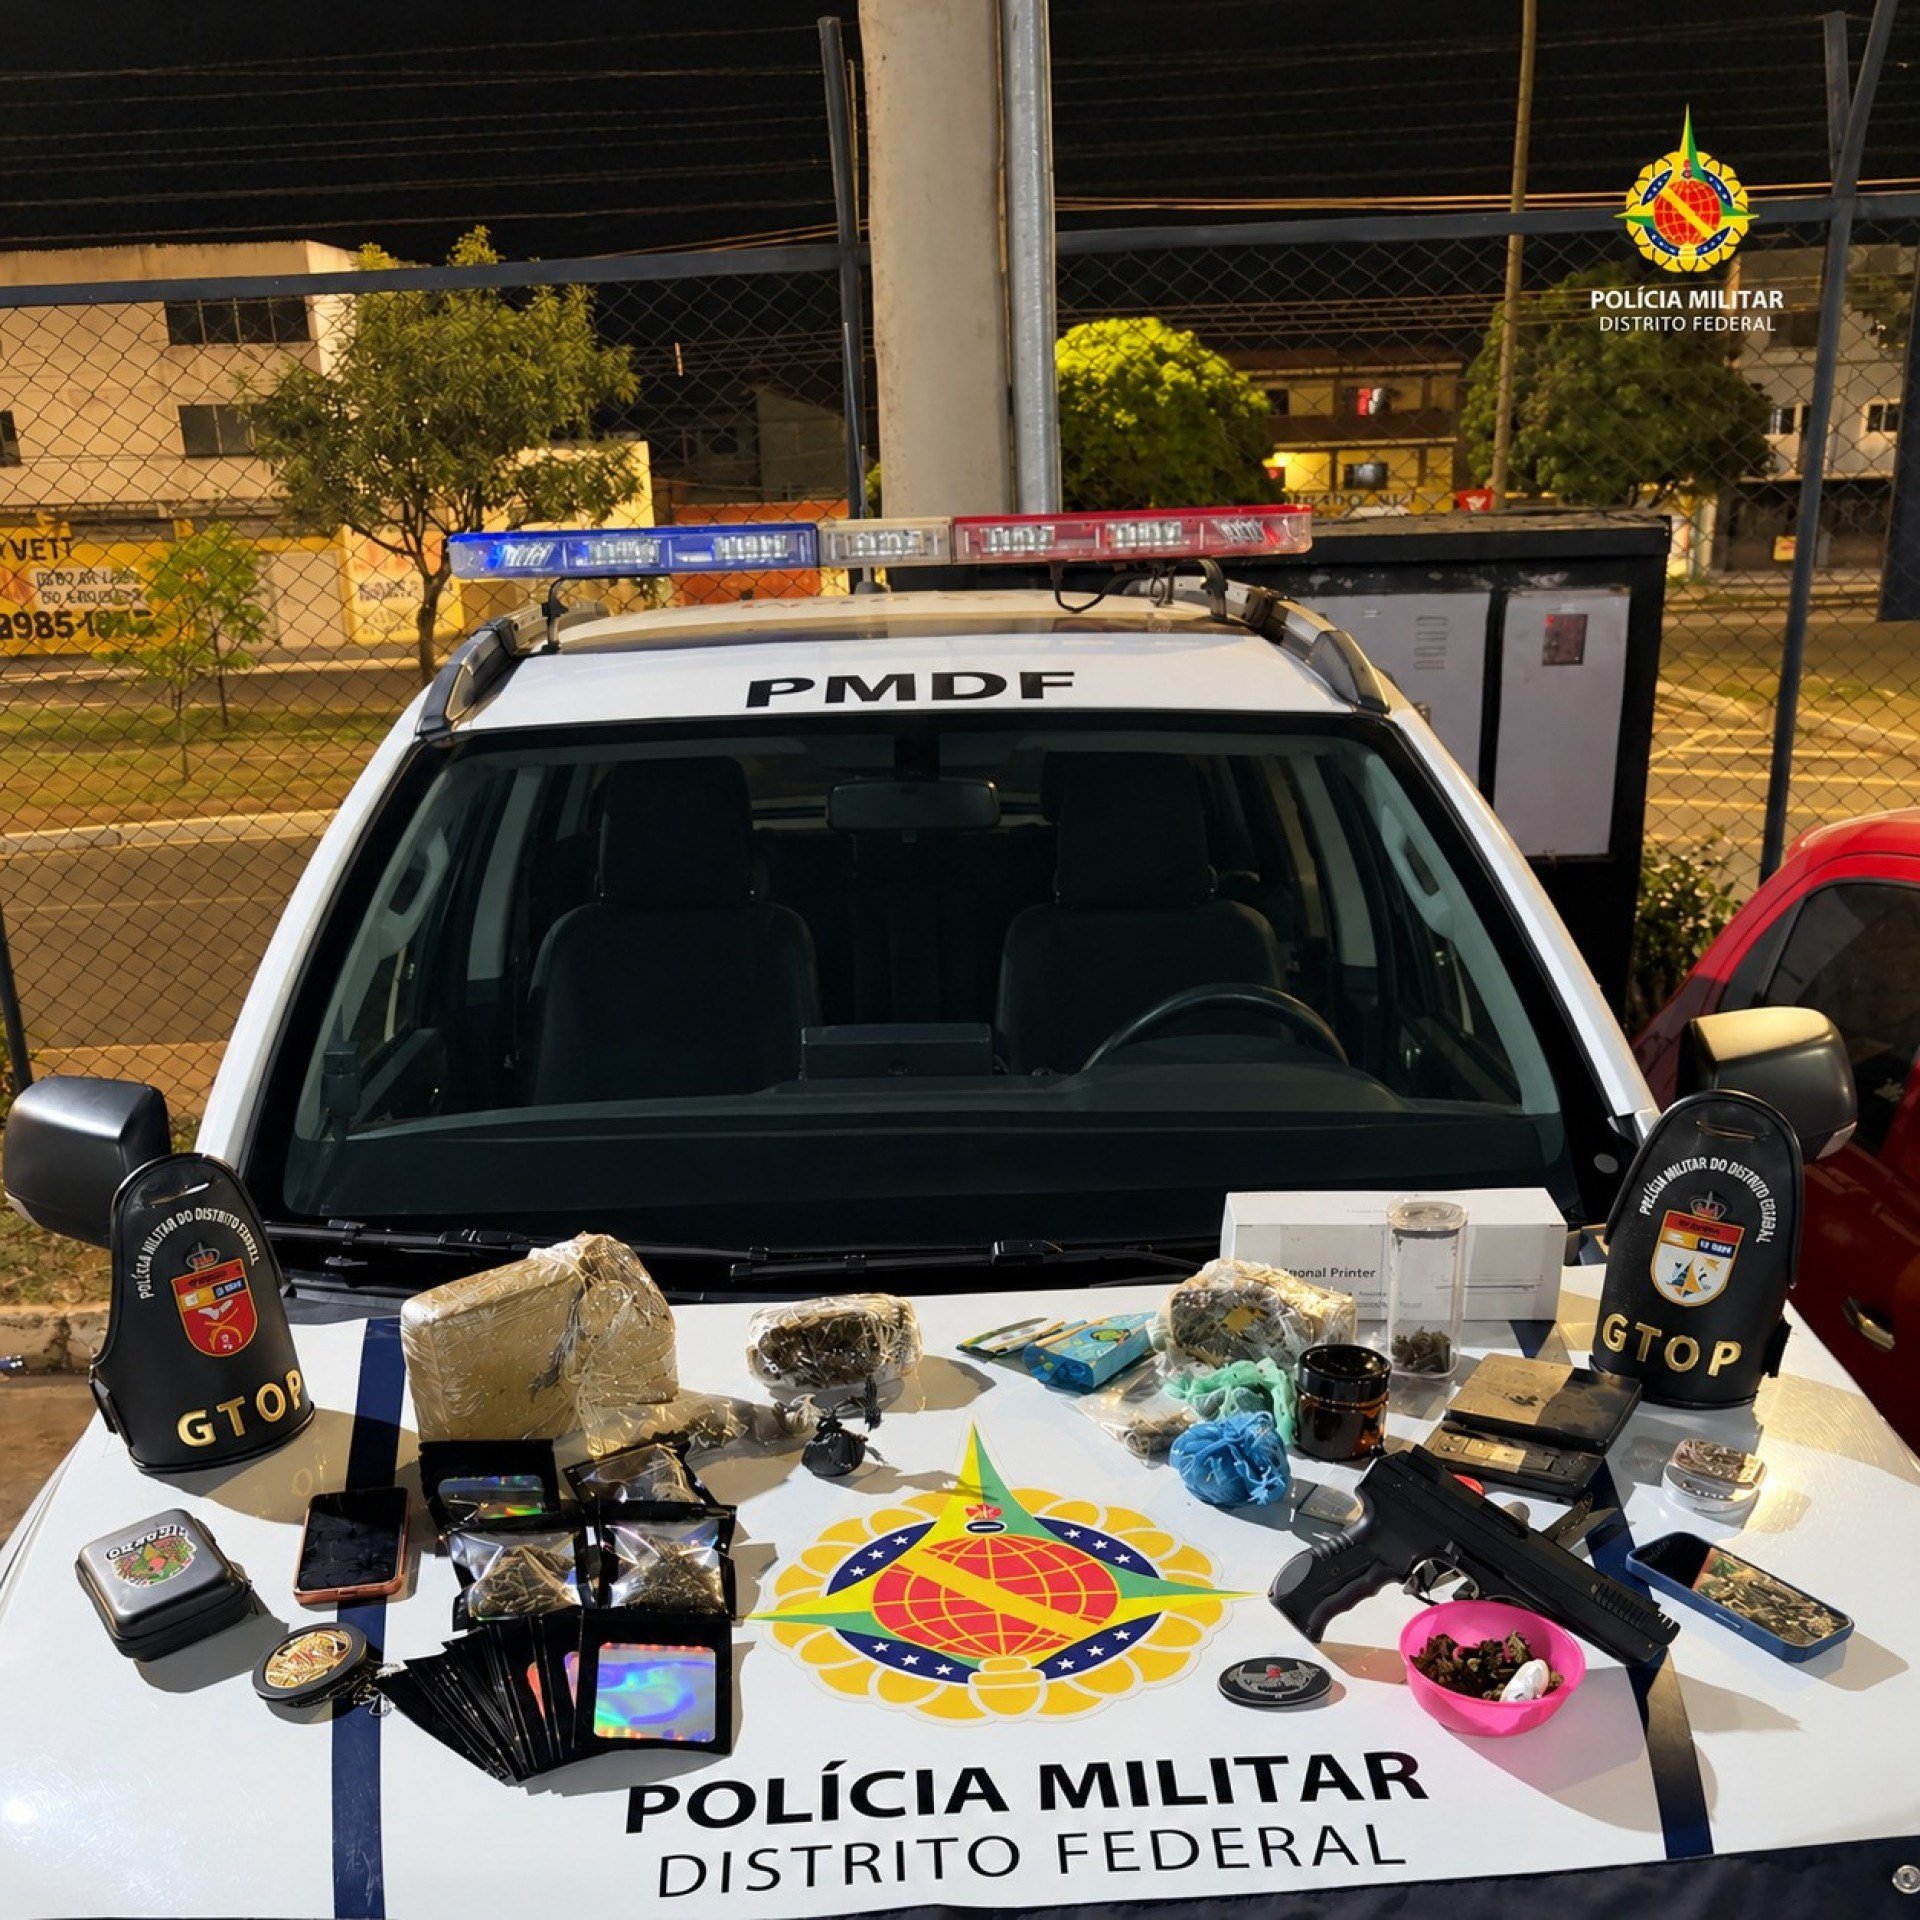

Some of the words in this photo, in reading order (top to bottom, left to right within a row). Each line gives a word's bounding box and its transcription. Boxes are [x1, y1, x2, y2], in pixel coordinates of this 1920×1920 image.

[746, 671, 1075, 708] PMDF
[1709, 1157, 1728, 1172] DO
[175, 1210, 194, 1226] DO
[1330, 1267, 1376, 1278] Printer
[1602, 1313, 1742, 1377] GTOP
[177, 1369, 302, 1448] GTOP
[625, 1759, 1010, 1834] POLÍCIA
[1039, 1751, 1430, 1811] MILITAR
[658, 1835, 1021, 1898] DISTRITO
[1056, 1823, 1407, 1875] FEDERAL
